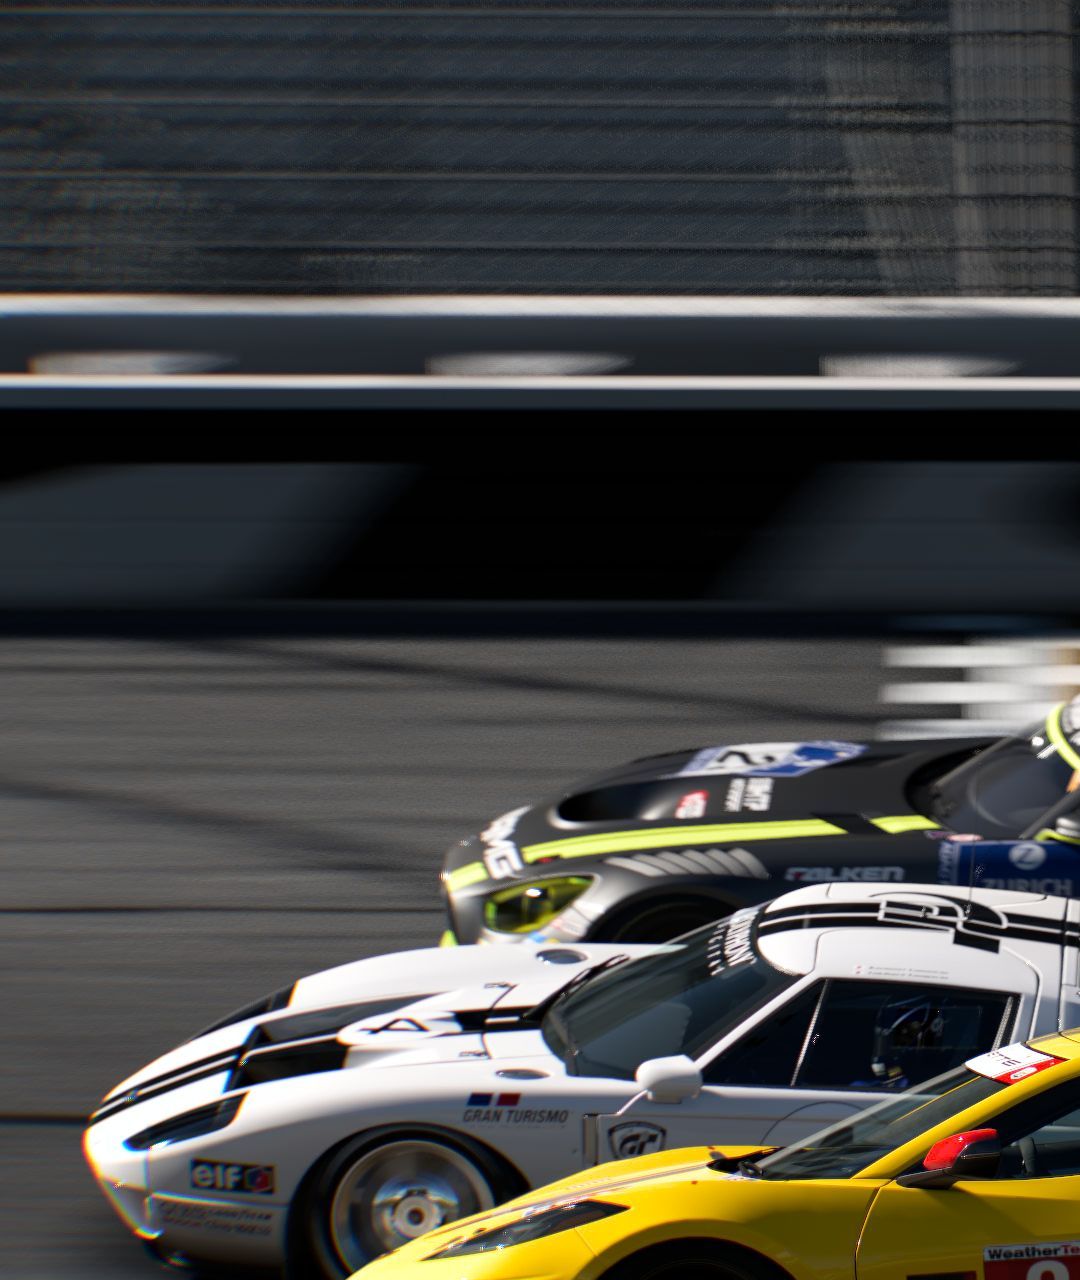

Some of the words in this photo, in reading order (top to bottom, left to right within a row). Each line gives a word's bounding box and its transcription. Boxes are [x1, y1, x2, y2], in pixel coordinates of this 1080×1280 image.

[784, 867, 905, 882] FALKEN
[463, 1109, 505, 1122] GRAN
[506, 1109, 569, 1123] TURISMO
[192, 1162, 242, 1189] elf
